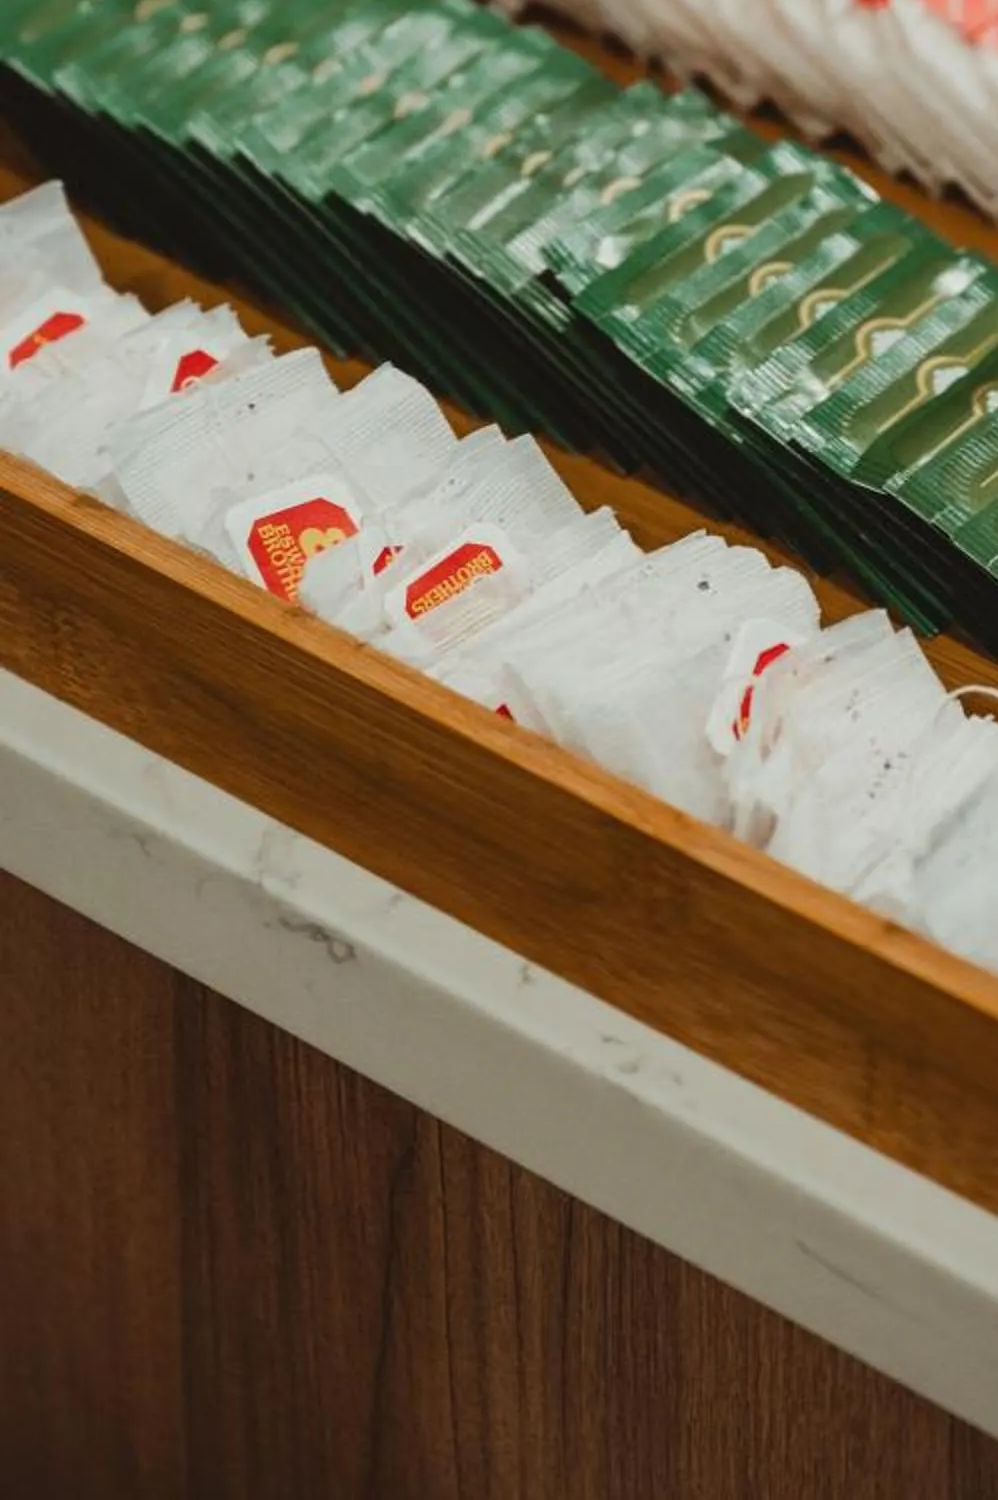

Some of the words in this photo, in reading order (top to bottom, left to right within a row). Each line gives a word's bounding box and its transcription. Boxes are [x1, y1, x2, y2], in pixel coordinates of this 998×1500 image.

[257, 523, 299, 602] BROTH
[276, 524, 307, 582] ESWA
[411, 549, 495, 614] BROTHERS
